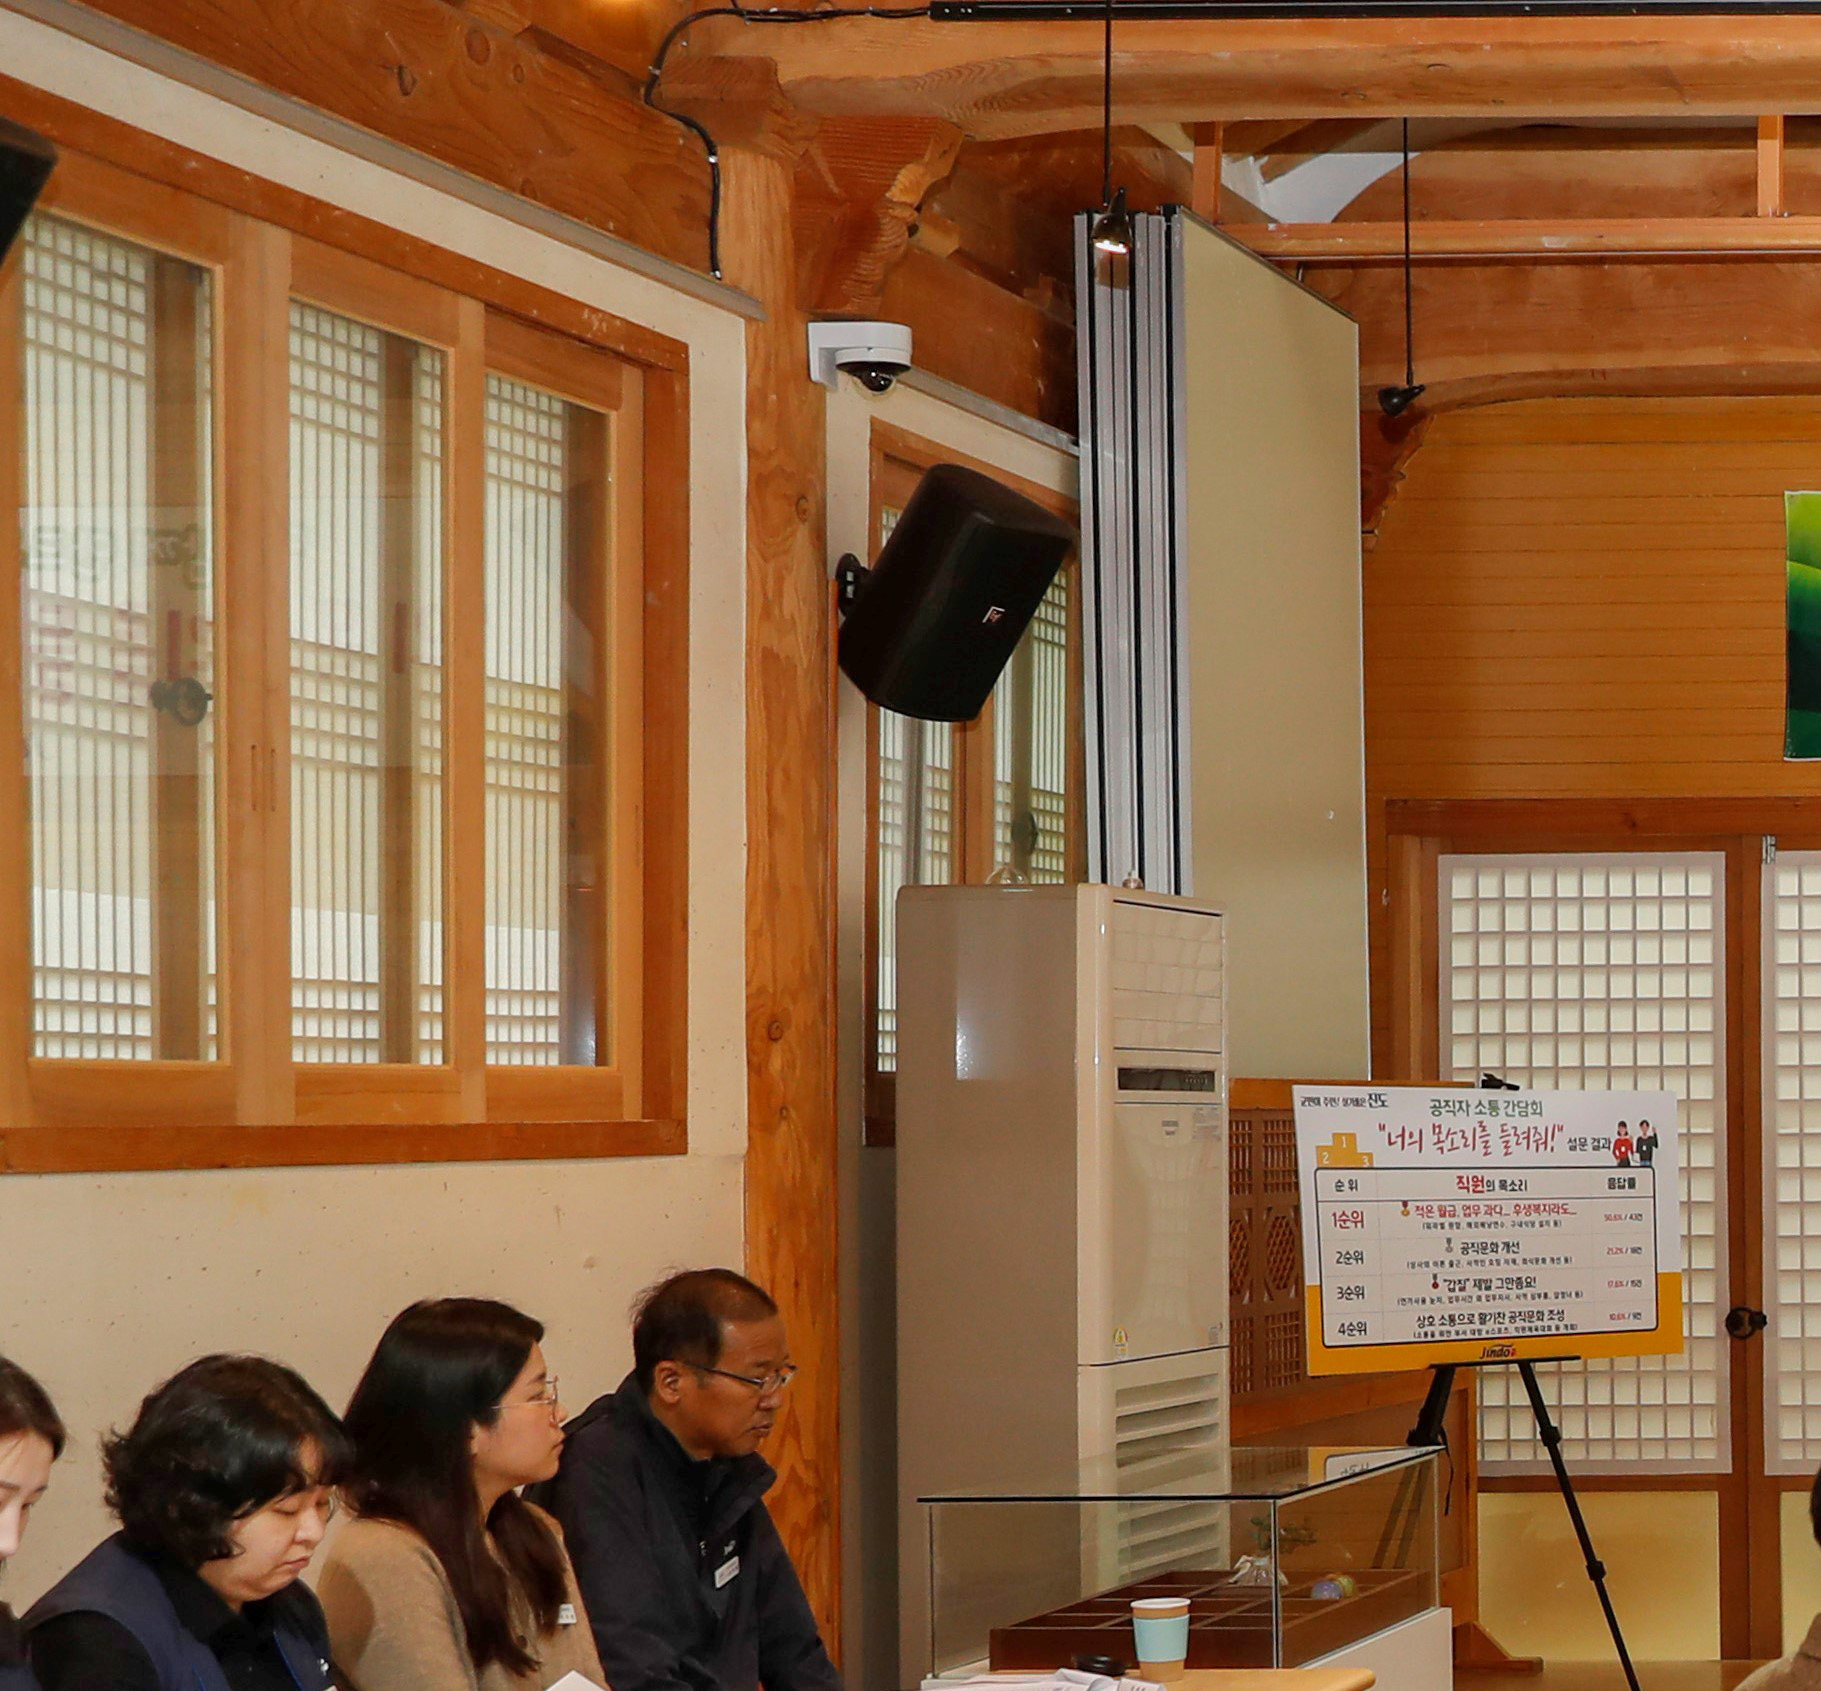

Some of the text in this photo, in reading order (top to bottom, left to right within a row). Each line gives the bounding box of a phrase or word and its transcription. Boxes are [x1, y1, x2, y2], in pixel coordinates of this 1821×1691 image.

[1368, 1093, 1388, 1108] 진도
[1429, 1099, 1543, 1117] 공직자 소통 간담회
[1342, 1137, 1347, 1148] 1
[1379, 1120, 1563, 1157] "너의 목소리를 들려줘!"
[1567, 1137, 1611, 1151] 설문 결과
[1322, 1152, 1330, 1164] 2
[1362, 1155, 1370, 1167] 3
[1456, 1175, 1528, 1194] 직원의 목소리
[1415, 1205, 1435, 1218] 적은
[1462, 1204, 1481, 1217] 업무
[1332, 1209, 1365, 1230] 1순위
[1460, 1240, 1521, 1255] 공직문화 개선
[1335, 1250, 1365, 1266] 2순위
[1473, 1277, 1492, 1292] 제발
[1336, 1285, 1366, 1301] 3순위
[1416, 1309, 1565, 1329] 상호 소통으로 활기찬 공직문화 조성
[1338, 1320, 1367, 1337] 4순위
[1480, 1345, 1511, 1359] Jindo
